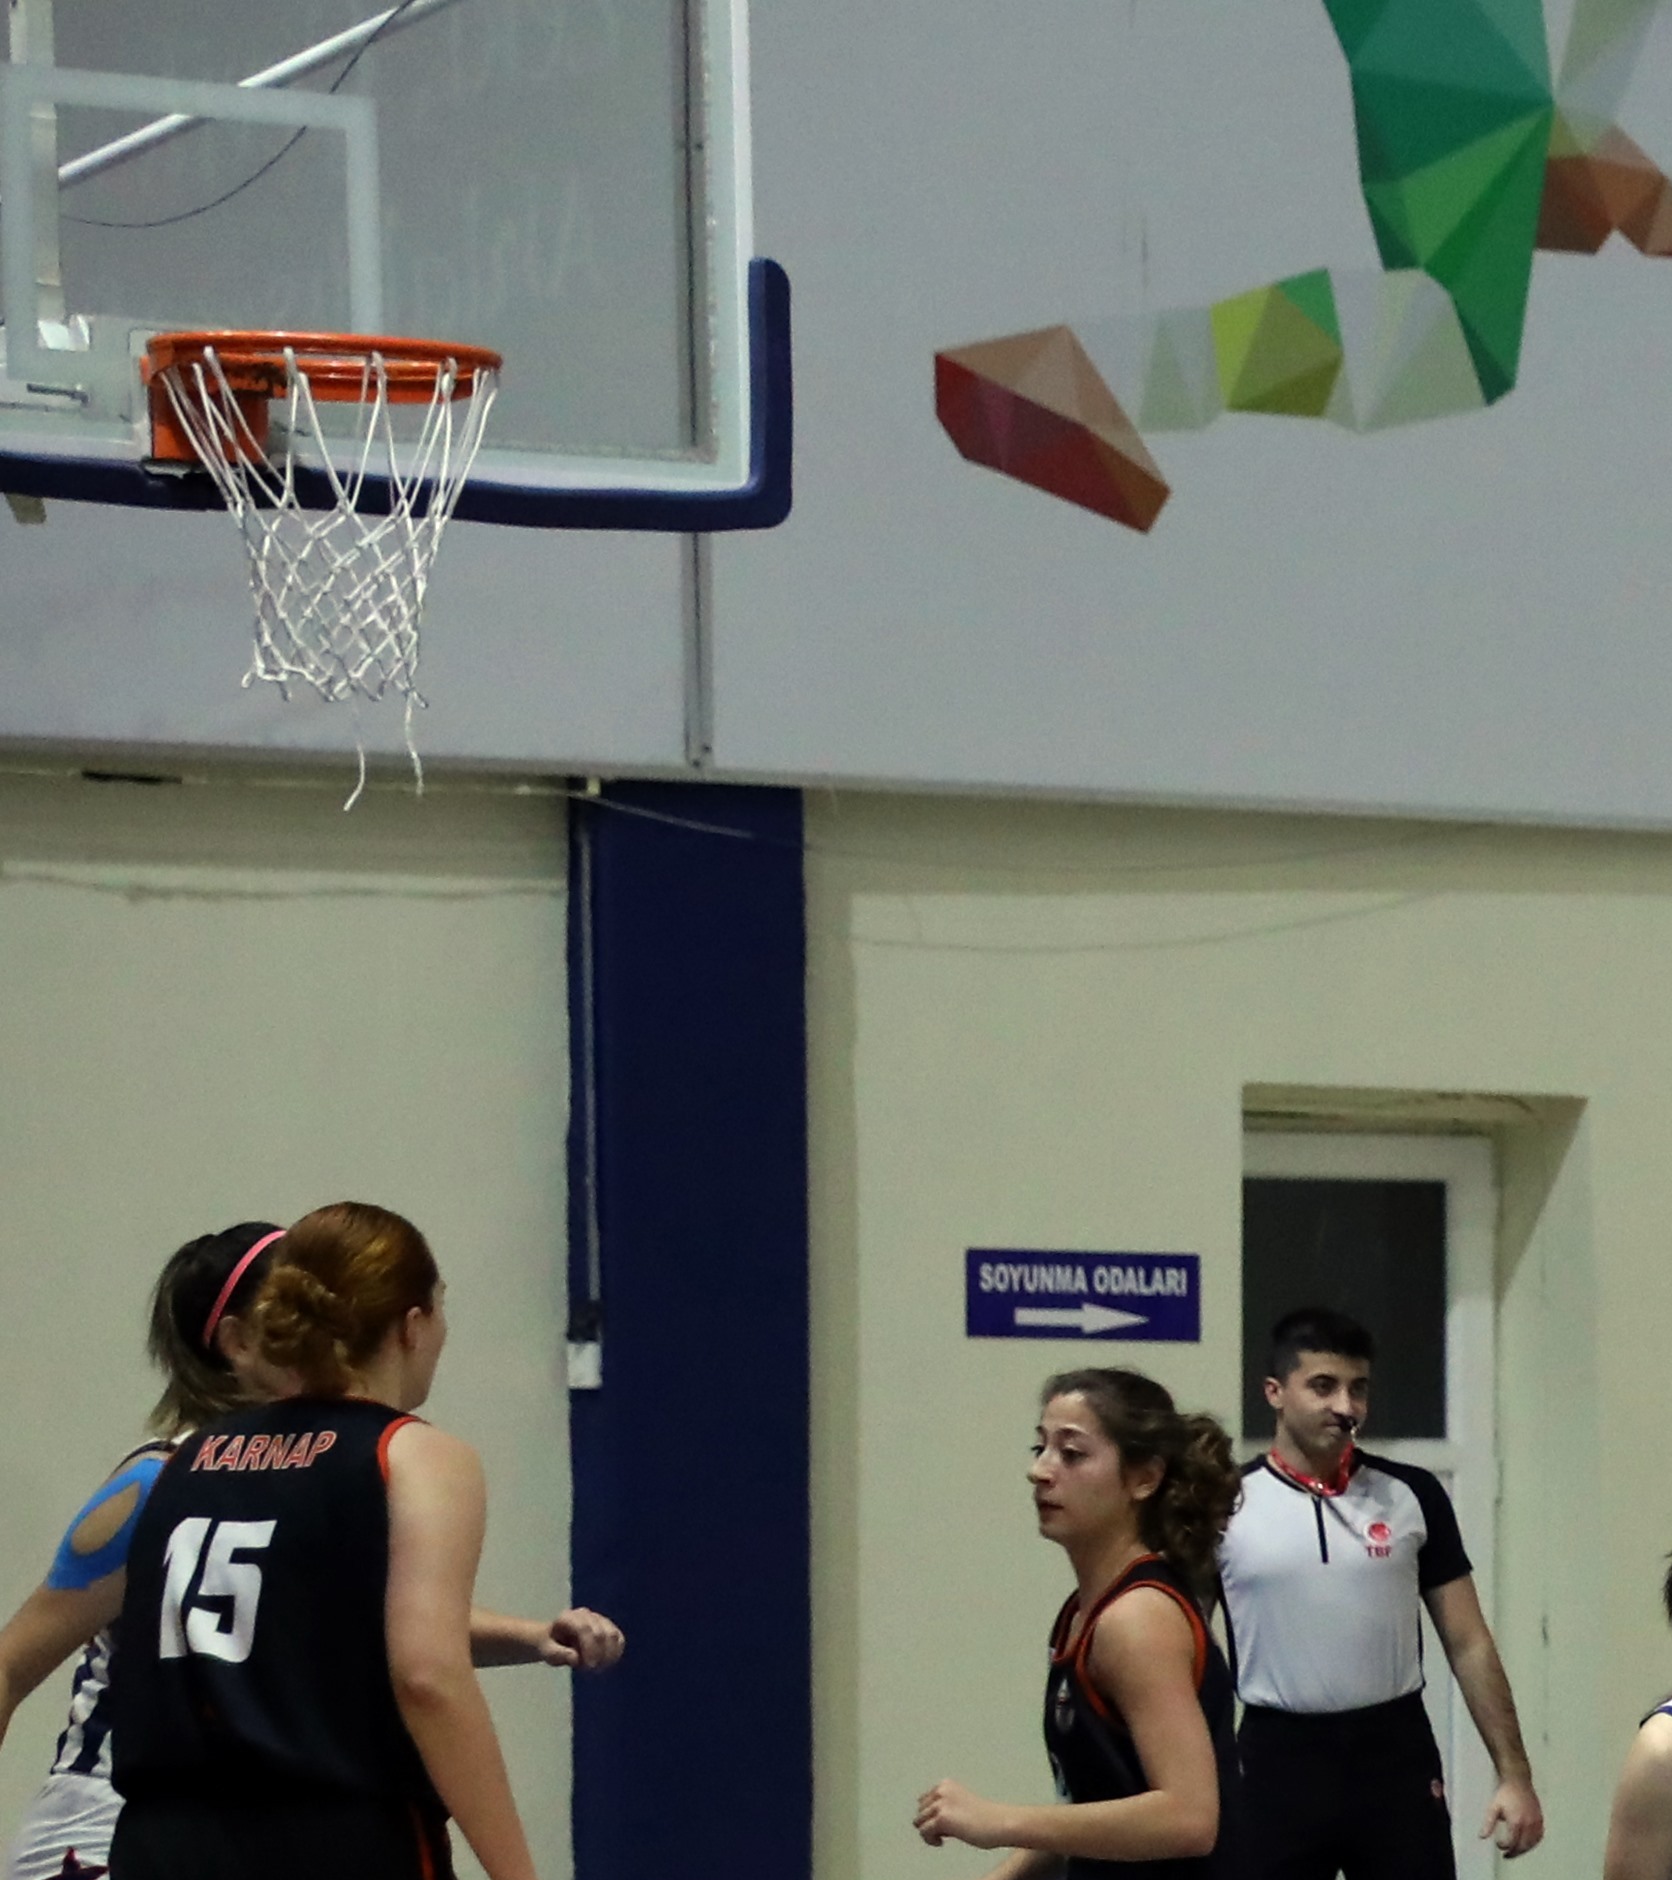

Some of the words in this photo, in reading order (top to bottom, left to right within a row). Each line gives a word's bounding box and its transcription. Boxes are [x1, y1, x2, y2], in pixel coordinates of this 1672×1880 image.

[979, 1262, 1089, 1294] SOYUNMA
[1092, 1264, 1189, 1297] ODALARI
[190, 1430, 338, 1472] KARNAP
[159, 1516, 279, 1664] 15
